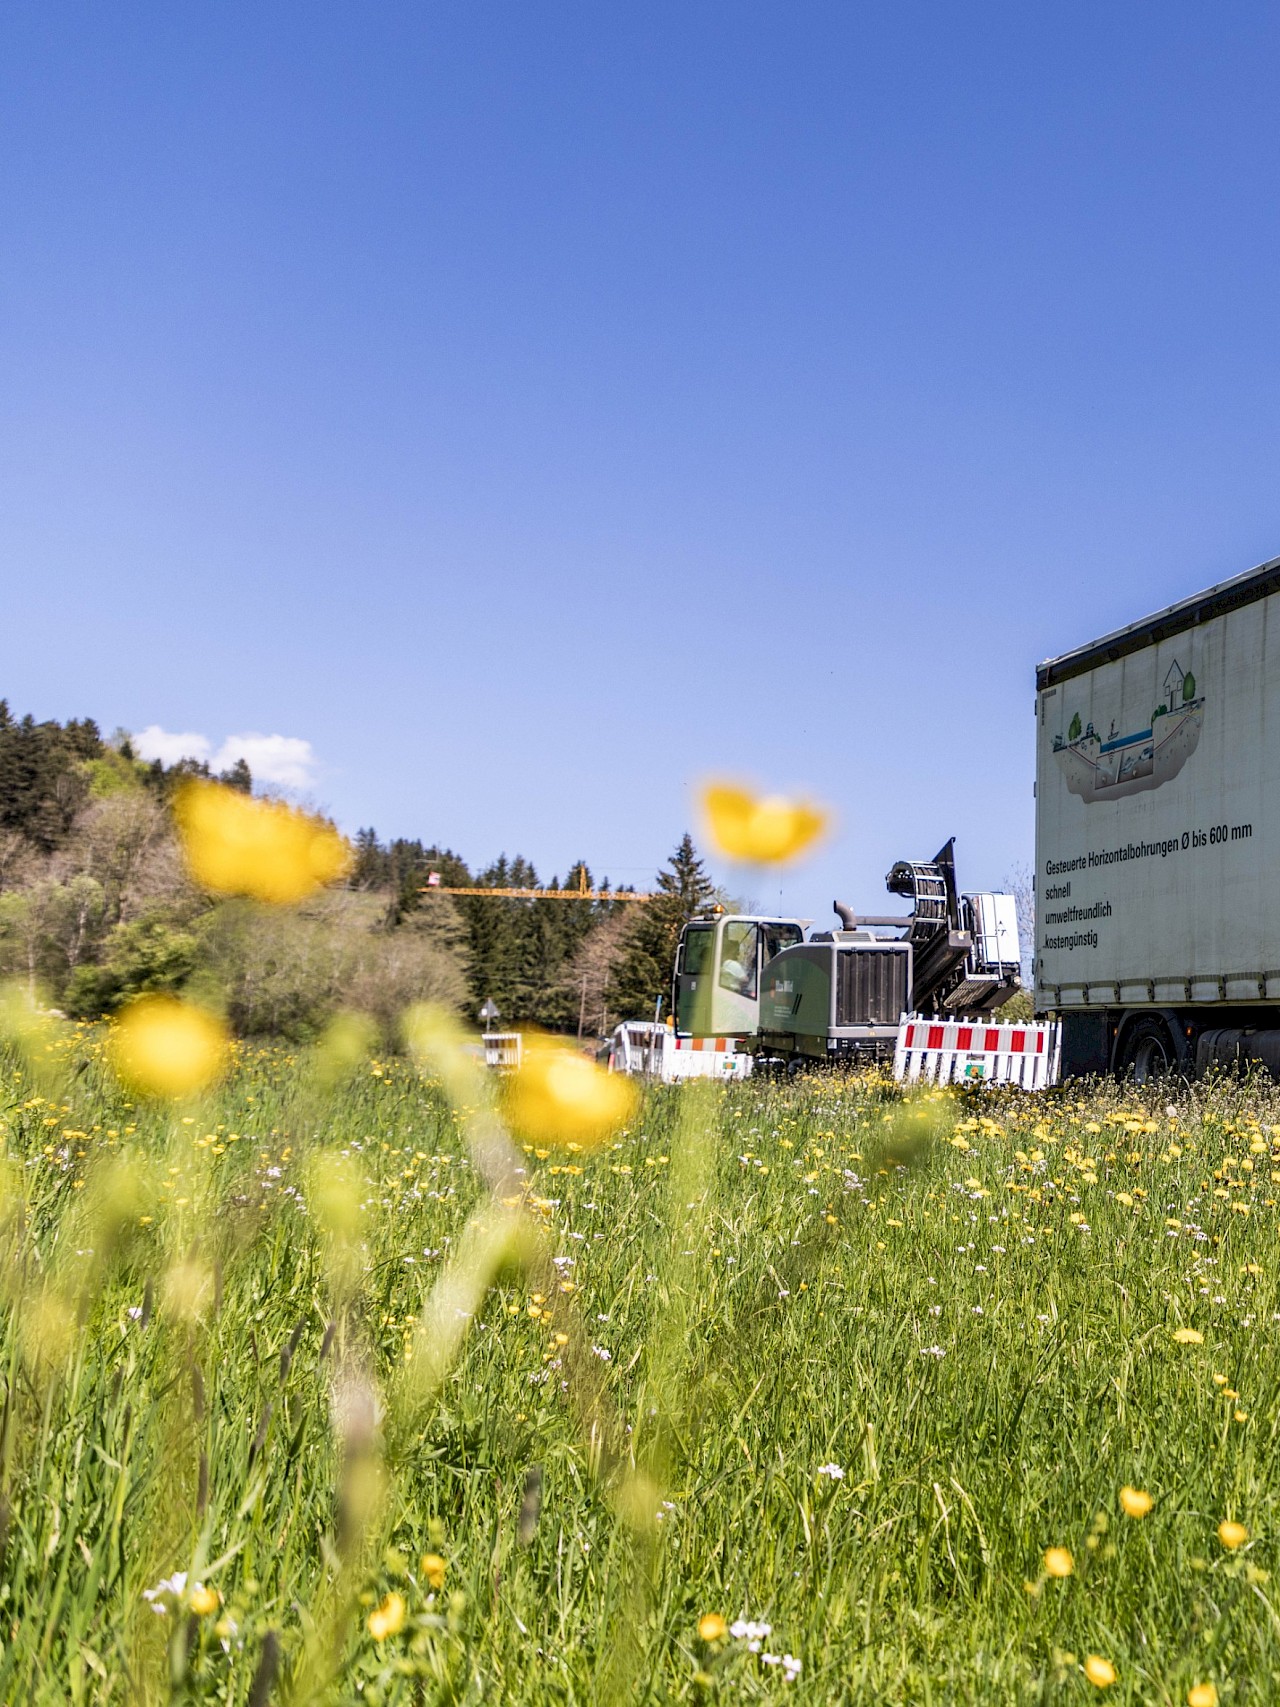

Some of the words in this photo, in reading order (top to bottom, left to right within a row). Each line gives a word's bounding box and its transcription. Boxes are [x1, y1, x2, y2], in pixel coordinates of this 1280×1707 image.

[1046, 856, 1086, 875] Gesteuerte
[1088, 837, 1179, 868] Horizontalbohrungen
[1192, 829, 1207, 848] bis
[1209, 824, 1228, 844] 600
[1231, 823, 1252, 840] mm
[1045, 881, 1071, 900] schnell
[1045, 901, 1112, 924] umweltfreundlich
[1045, 930, 1097, 950] kostengünstig
